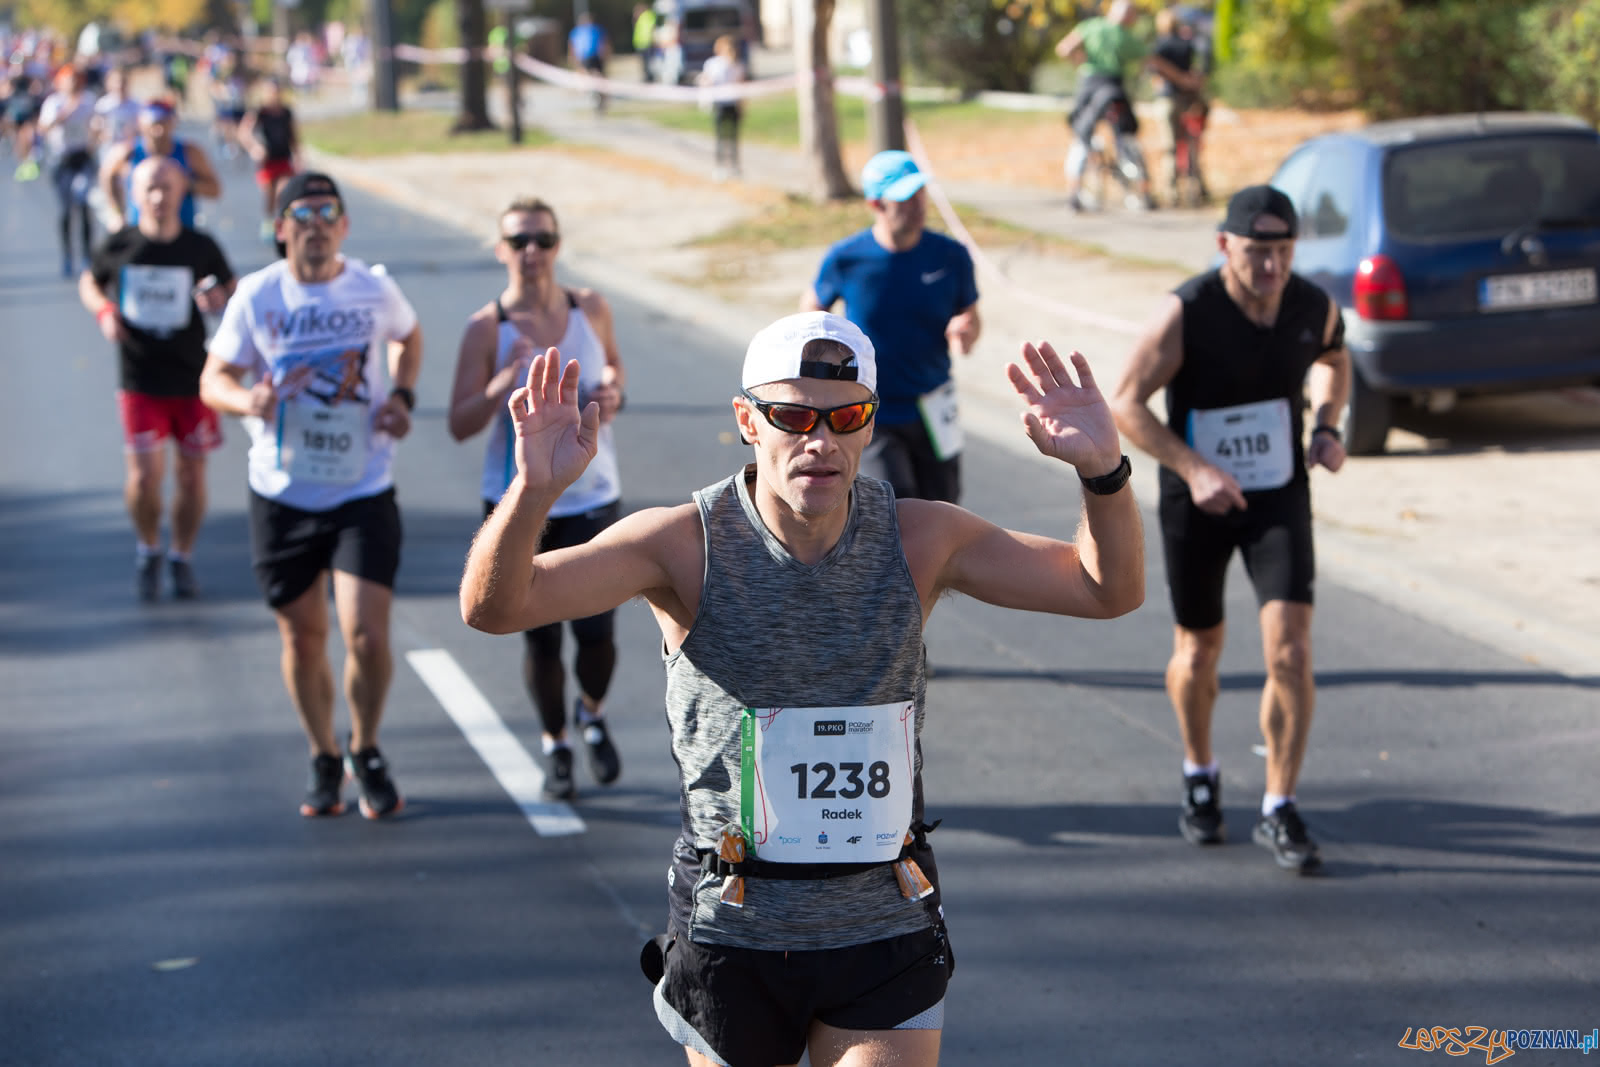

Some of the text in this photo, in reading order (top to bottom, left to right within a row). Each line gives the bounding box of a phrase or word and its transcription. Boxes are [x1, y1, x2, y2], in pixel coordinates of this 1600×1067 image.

[302, 429, 353, 454] 1810
[1216, 433, 1271, 458] 4118
[790, 761, 891, 799] 1238
[821, 808, 863, 820] Radek
